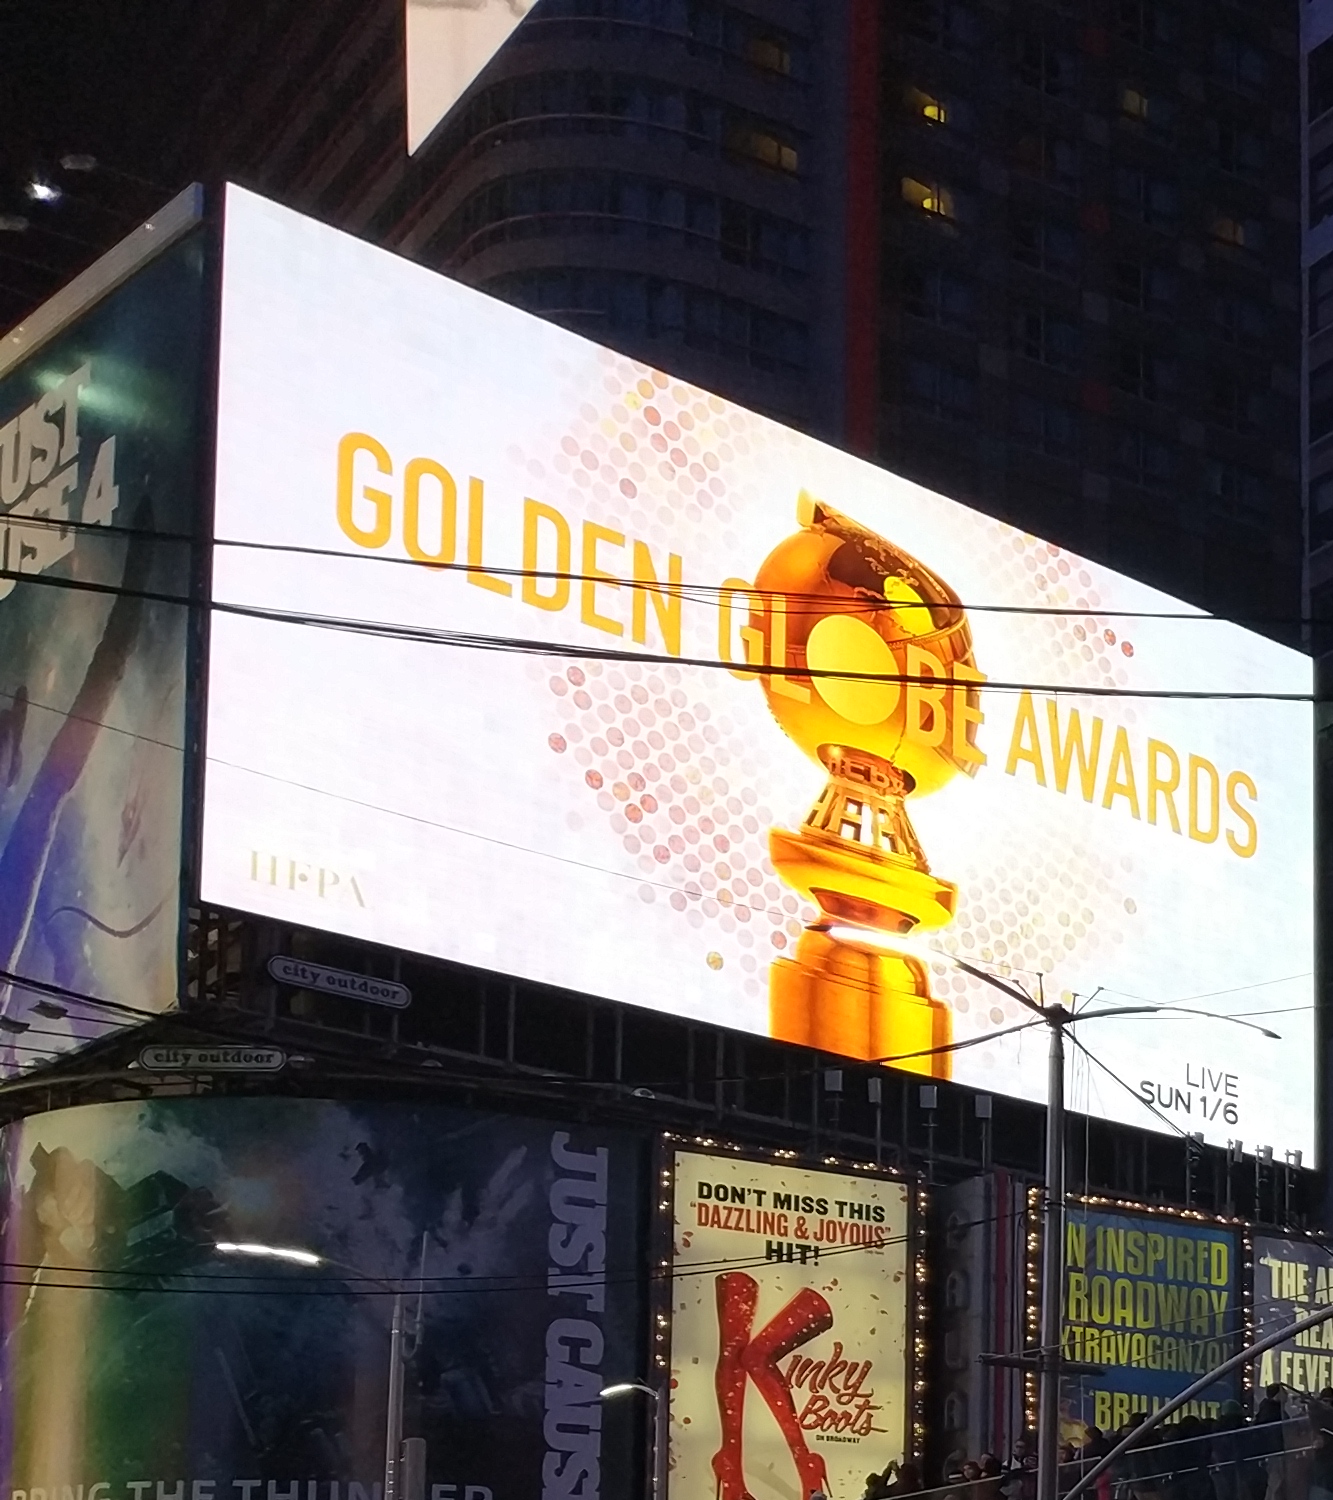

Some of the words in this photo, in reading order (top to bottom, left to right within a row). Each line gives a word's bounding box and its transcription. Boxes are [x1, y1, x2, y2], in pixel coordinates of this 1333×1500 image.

[336, 431, 682, 658] GOLDEN
[1005, 689, 1258, 859] AWARDS
[283, 963, 320, 985] city
[327, 974, 401, 1001] outdoor
[154, 1050, 193, 1068] city
[198, 1047, 274, 1064] outdoor
[1185, 1063, 1240, 1098] LIVE
[1139, 1080, 1191, 1115] SUN
[1199, 1096, 1240, 1126] 1/6
[548, 1131, 608, 1312] JUST
[697, 1181, 767, 1208] DON'T
[773, 1189, 829, 1216] MISS
[834, 1200, 885, 1224] THIS
[690, 1200, 788, 1238] "DAZZLING
[794, 1215, 809, 1241] &
[812, 1216, 892, 1250] JOYOUS"
[765, 1240, 820, 1267] HIT!
[1096, 1223, 1228, 1287] INSPIRED
[1062, 1273, 1228, 1336] ROADWAY
[1260, 1350, 1274, 1388] A
[799, 1394, 889, 1437] Boots
[826, 1435, 860, 1444] BROADWAY
